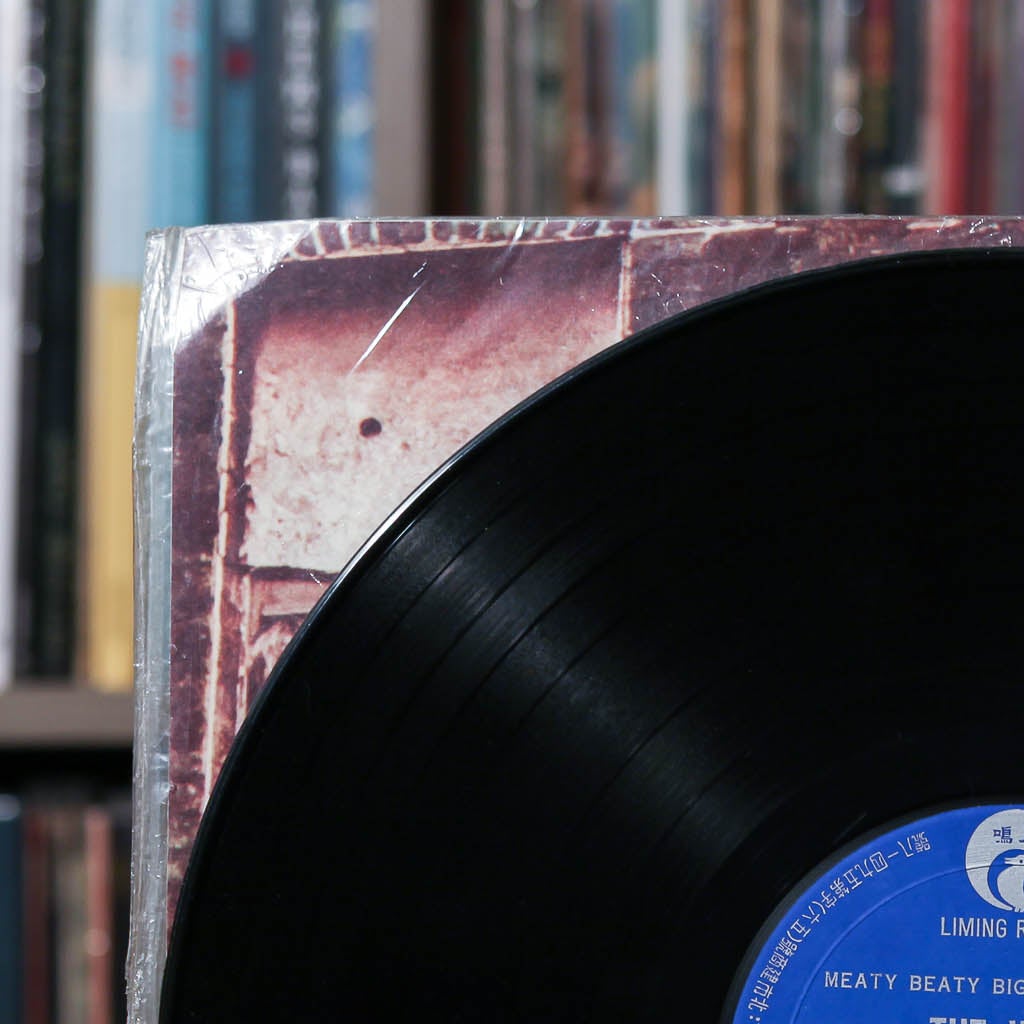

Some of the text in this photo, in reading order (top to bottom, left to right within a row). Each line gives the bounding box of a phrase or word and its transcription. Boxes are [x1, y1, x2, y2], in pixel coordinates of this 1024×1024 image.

[940, 916, 1007, 939] LIMING
[824, 971, 897, 990] MEATY
[909, 974, 980, 994] BEATY
